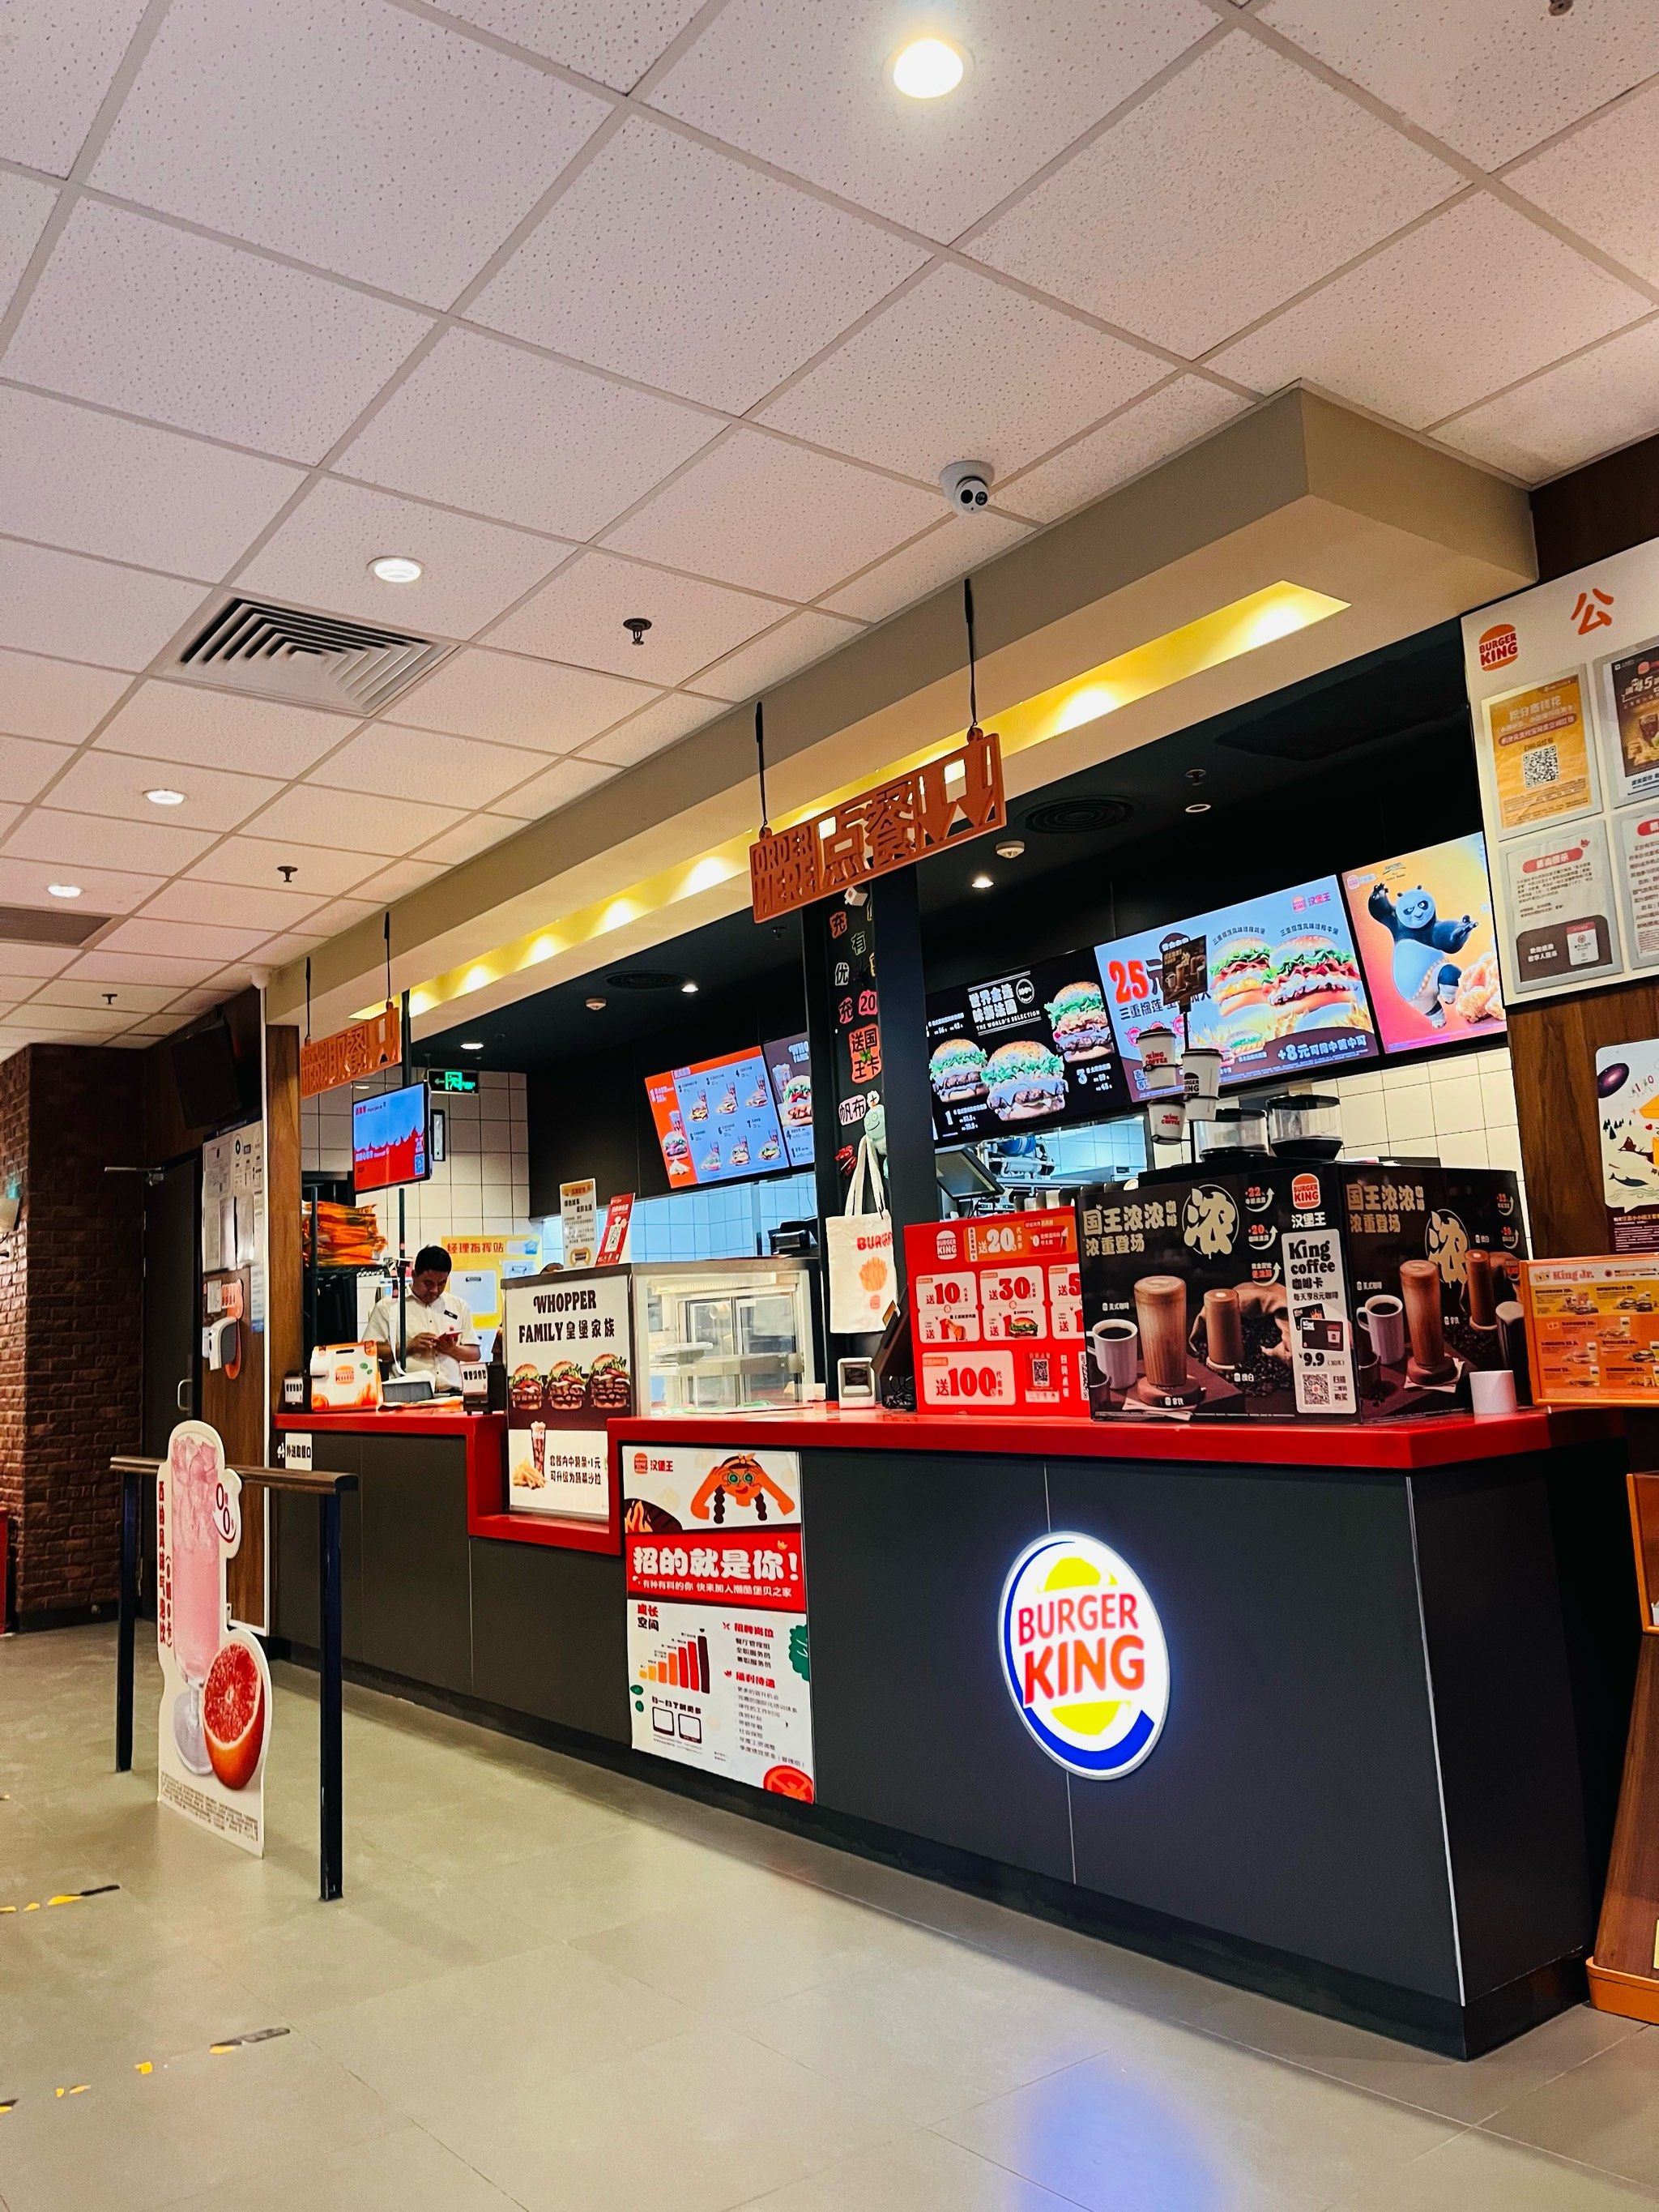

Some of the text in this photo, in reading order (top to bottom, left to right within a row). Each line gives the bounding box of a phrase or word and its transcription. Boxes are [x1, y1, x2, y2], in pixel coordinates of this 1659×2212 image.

[1571, 588, 1614, 635] 公
[1479, 633, 1516, 653] BURGER
[1480, 643, 1518, 666] KING
[753, 825, 812, 876] ORDER
[1308, 892, 1331, 907] 汉堡王
[831, 915, 846, 935] 充
[860, 995, 876, 1013] 20
[987, 1018, 1010, 1027] WORLD'S
[1011, 1010, 1040, 1022] SELECTION
[851, 1027, 877, 1053] 送国
[1077, 1069, 1087, 1084] 3
[1294, 1184, 1318, 1194] BURGER
[1294, 1191, 1319, 1202] KING
[1346, 1184, 1415, 1211] 国王浓浓
[1083, 1202, 1164, 1234] 国王浓浓
[1291, 1212, 1326, 1228] 汉堡王
[936, 1238, 956, 1246] BURGER
[937, 1245, 957, 1255] KING
[1085, 1233, 1145, 1257] 浓重登场
[1289, 1239, 1331, 1262] King
[1290, 1259, 1335, 1275] coffee
[1553, 1270, 1594, 1281] King Jr.
[1292, 1277, 1323, 1290] 咖啡卡
[534, 1289, 596, 1314] WHOPPER
[519, 1317, 615, 1343] FAMILY 皇堡家族
[990, 1326, 999, 1336] 送
[1059, 1317, 1068, 1332] 送
[927, 1329, 935, 1339] 送
[650, 1460, 673, 1471] 汉堡王
[216, 1483, 224, 1510] 0
[223, 1507, 230, 1535] 0
[638, 1616, 659, 1631] 空间
[1018, 1593, 1139, 1647] BURGER
[735, 1622, 774, 1638] 招聘岗位
[1025, 1634, 1145, 1705] KING
[736, 1672, 775, 1689] 福利待遇
